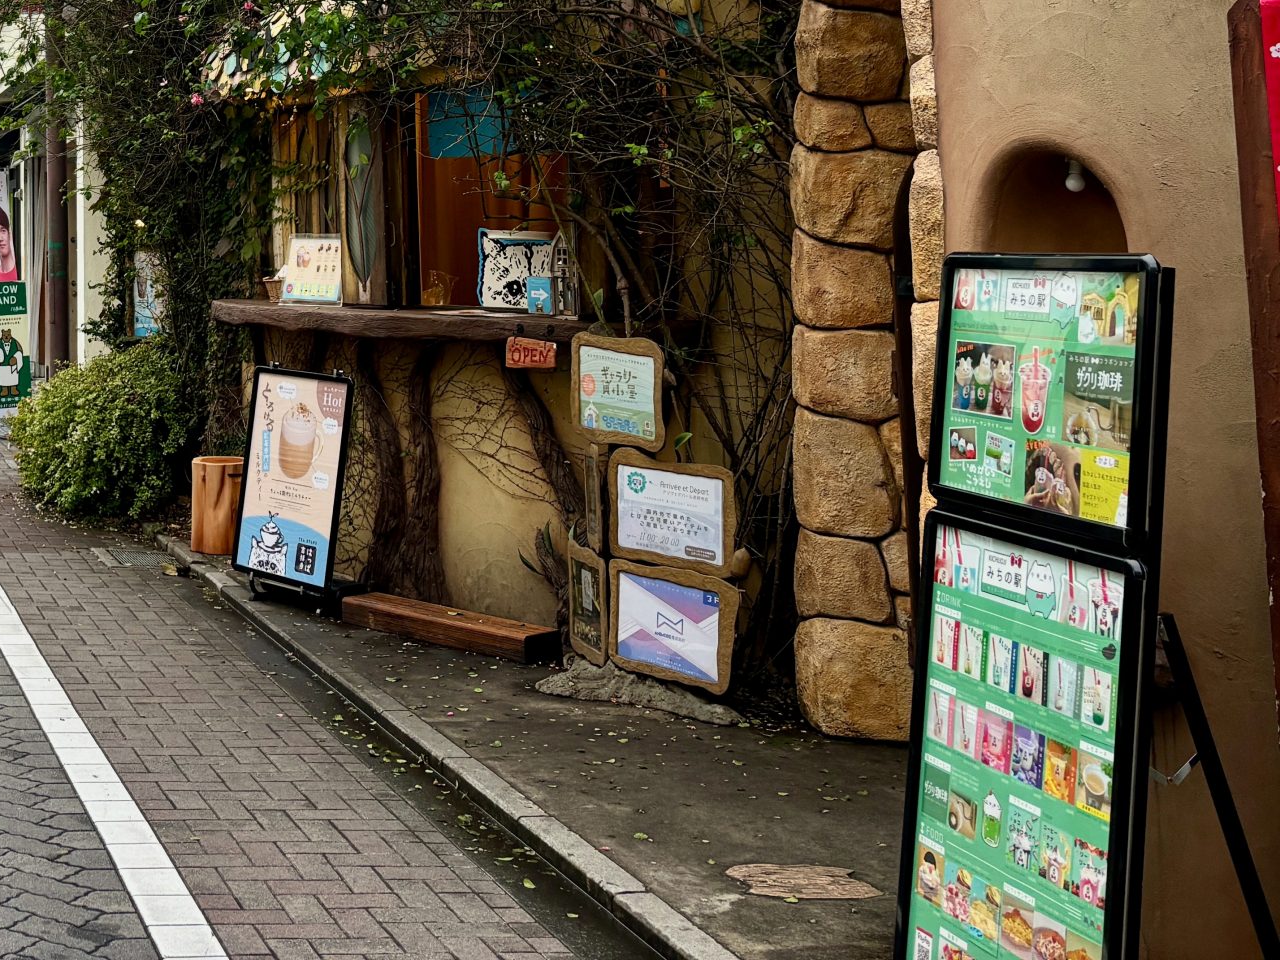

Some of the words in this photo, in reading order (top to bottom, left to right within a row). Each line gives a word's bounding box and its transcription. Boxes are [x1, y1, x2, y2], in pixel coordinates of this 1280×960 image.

[1010, 292, 1047, 308] みちの駅
[510, 343, 552, 364] OPEN
[1076, 367, 1124, 392] ザクリ珈琲
[323, 392, 343, 408] Hot
[987, 566, 1022, 588] みちの駅
[941, 592, 961, 608] DRINK
[998, 637, 1011, 655] BLUE
[926, 826, 944, 844] FOOD
